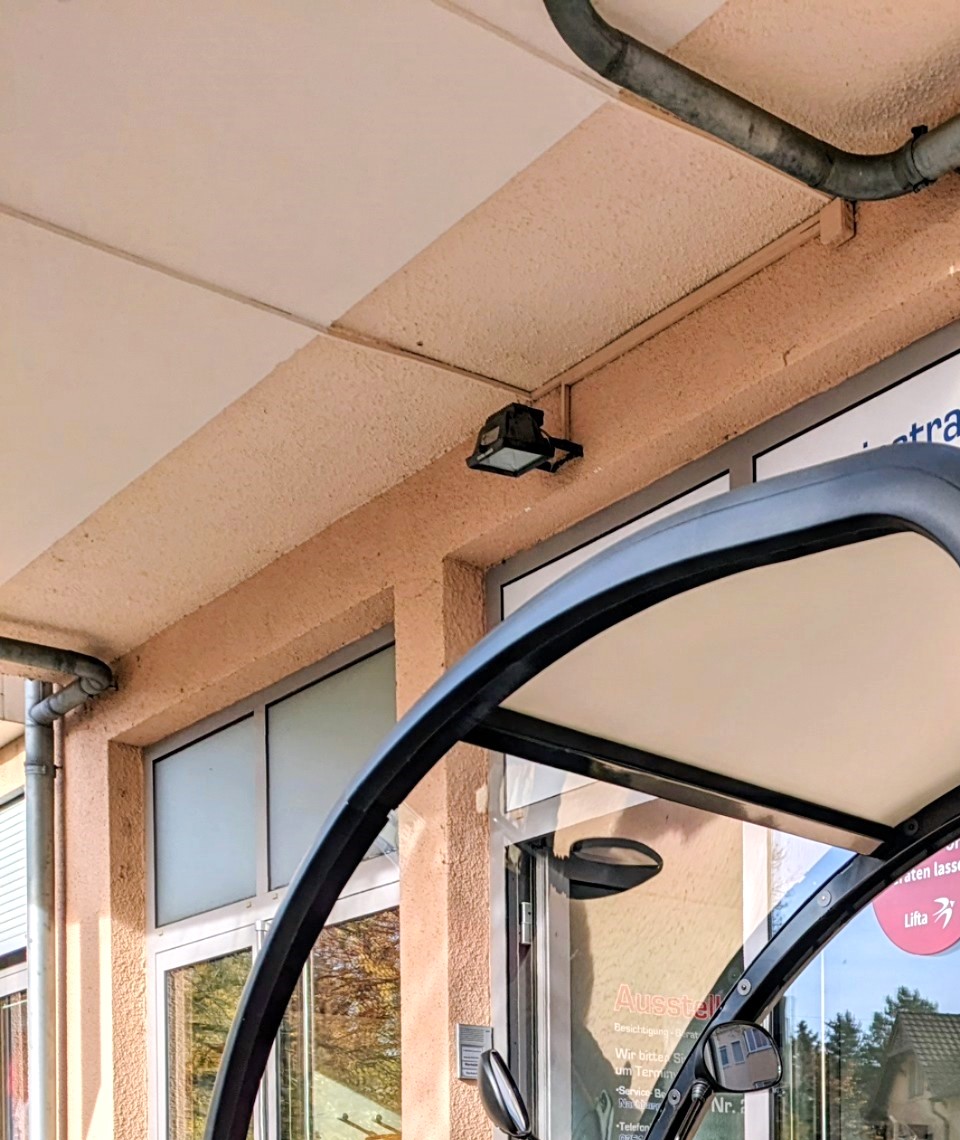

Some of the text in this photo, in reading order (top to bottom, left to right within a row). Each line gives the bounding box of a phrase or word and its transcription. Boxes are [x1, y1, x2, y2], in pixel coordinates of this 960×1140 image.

[904, 910, 928, 929] Lifta
[614, 1022, 669, 1039] Besichtigung
[615, 1047, 636, 1060] Wir
[615, 1068, 632, 1076] um
[711, 1097, 736, 1114] Nr.
